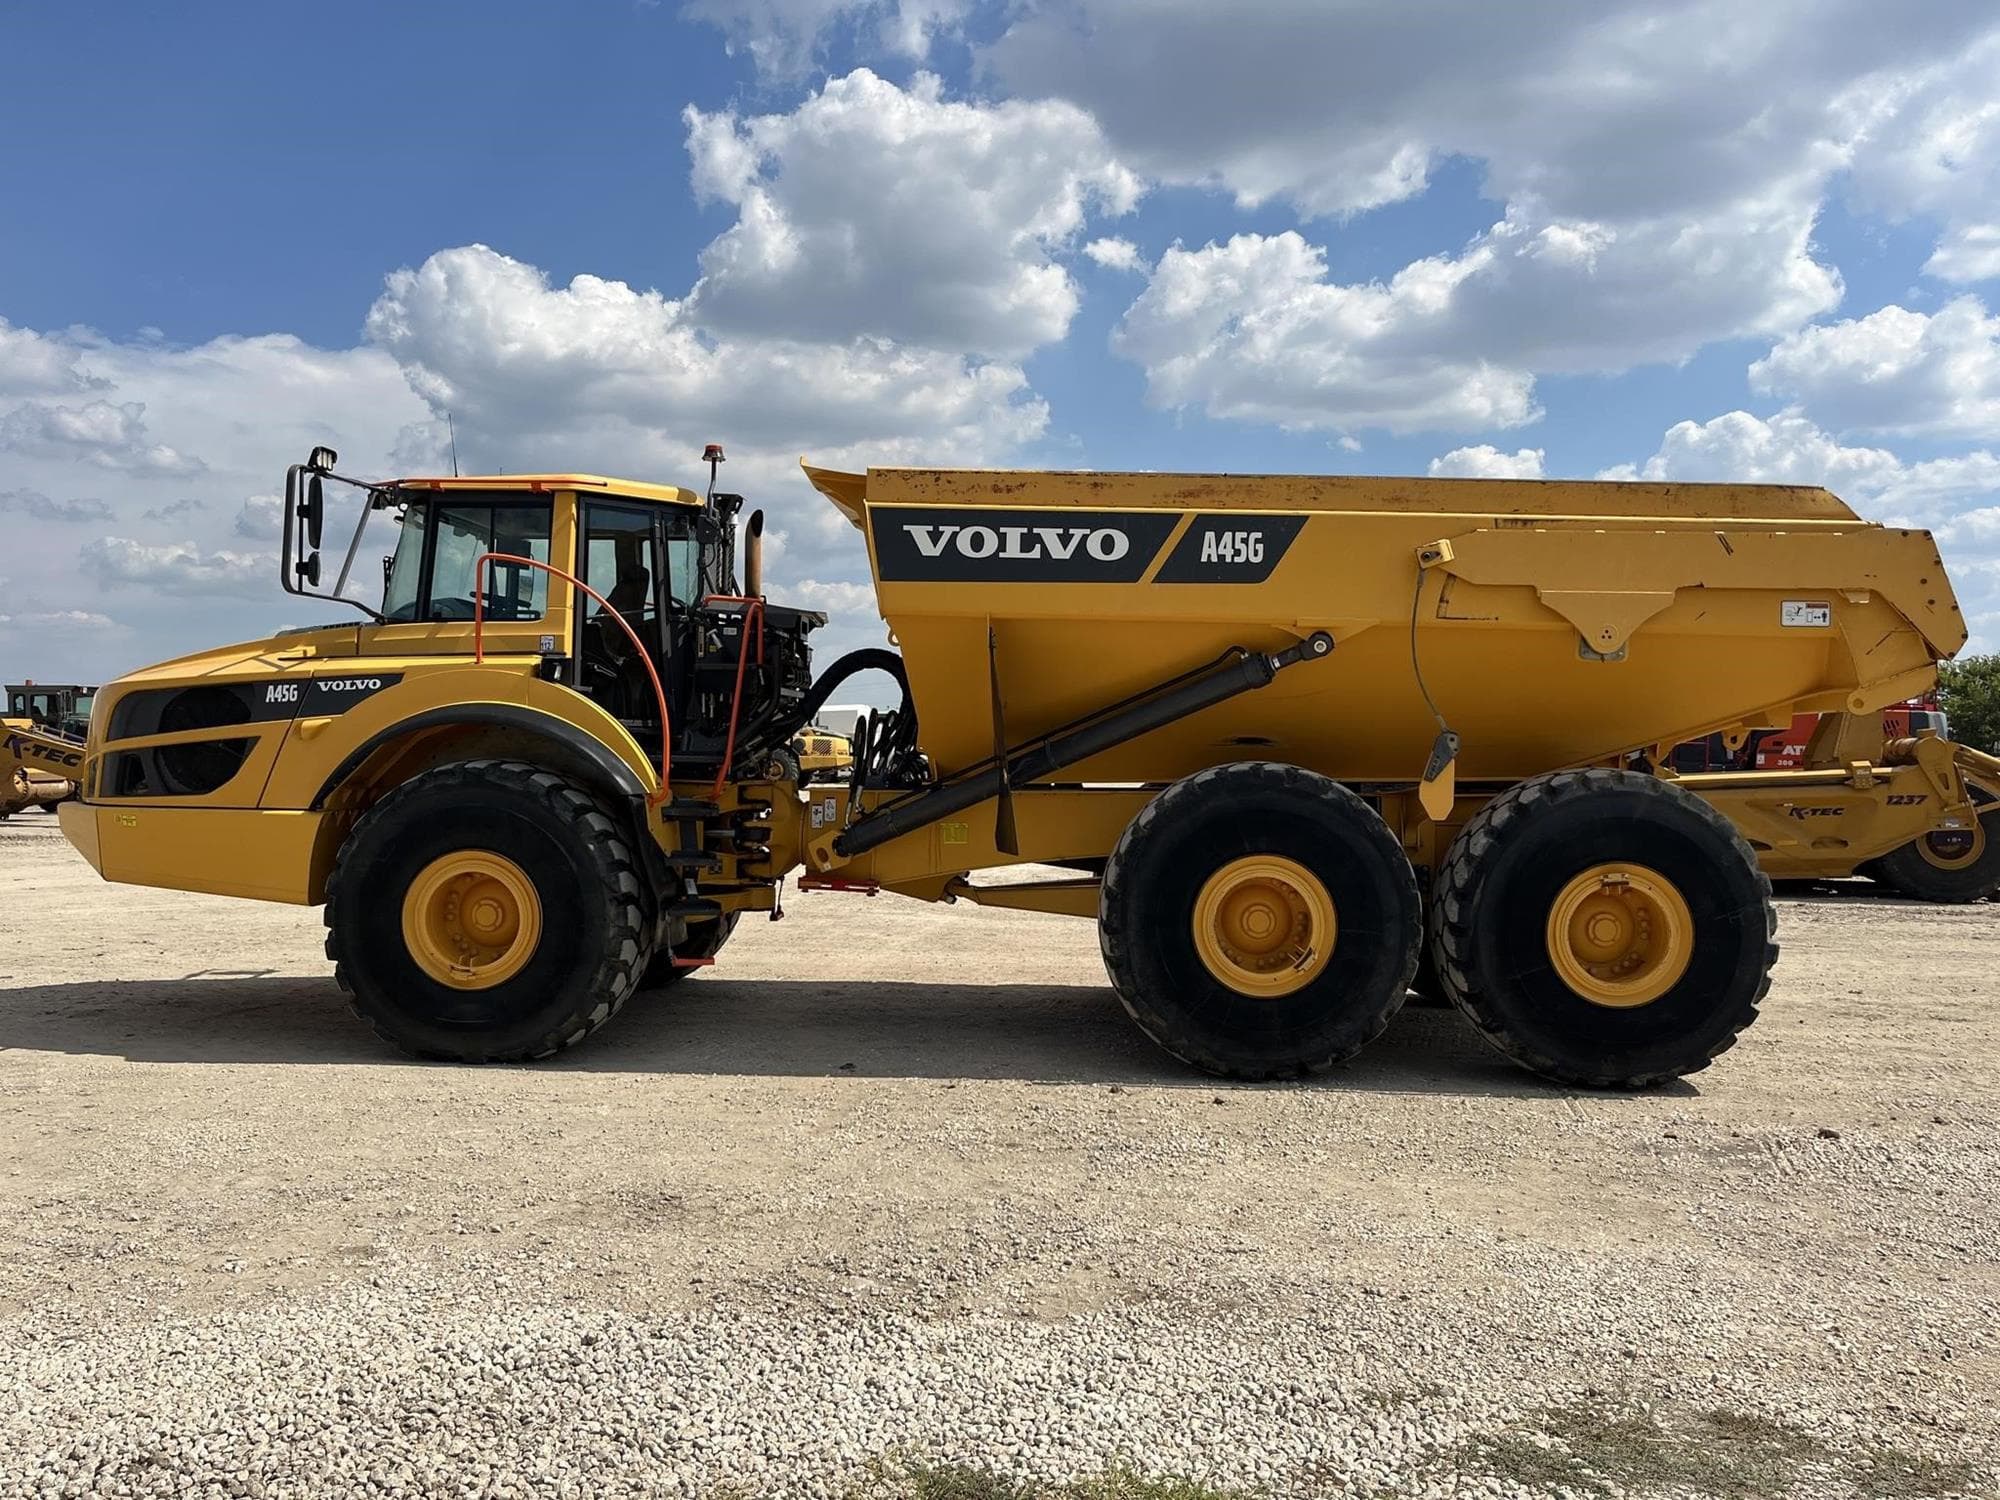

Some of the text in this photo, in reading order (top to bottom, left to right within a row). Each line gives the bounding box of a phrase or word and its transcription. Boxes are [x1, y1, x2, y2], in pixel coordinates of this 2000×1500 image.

[903, 525, 1264, 563] VOLVO A45G
[265, 678, 382, 703] A45G VOLVO
[2, 733, 82, 767] K-TEC
[1886, 795, 1928, 806] 1237
[1789, 807, 1844, 820] K-TEC
